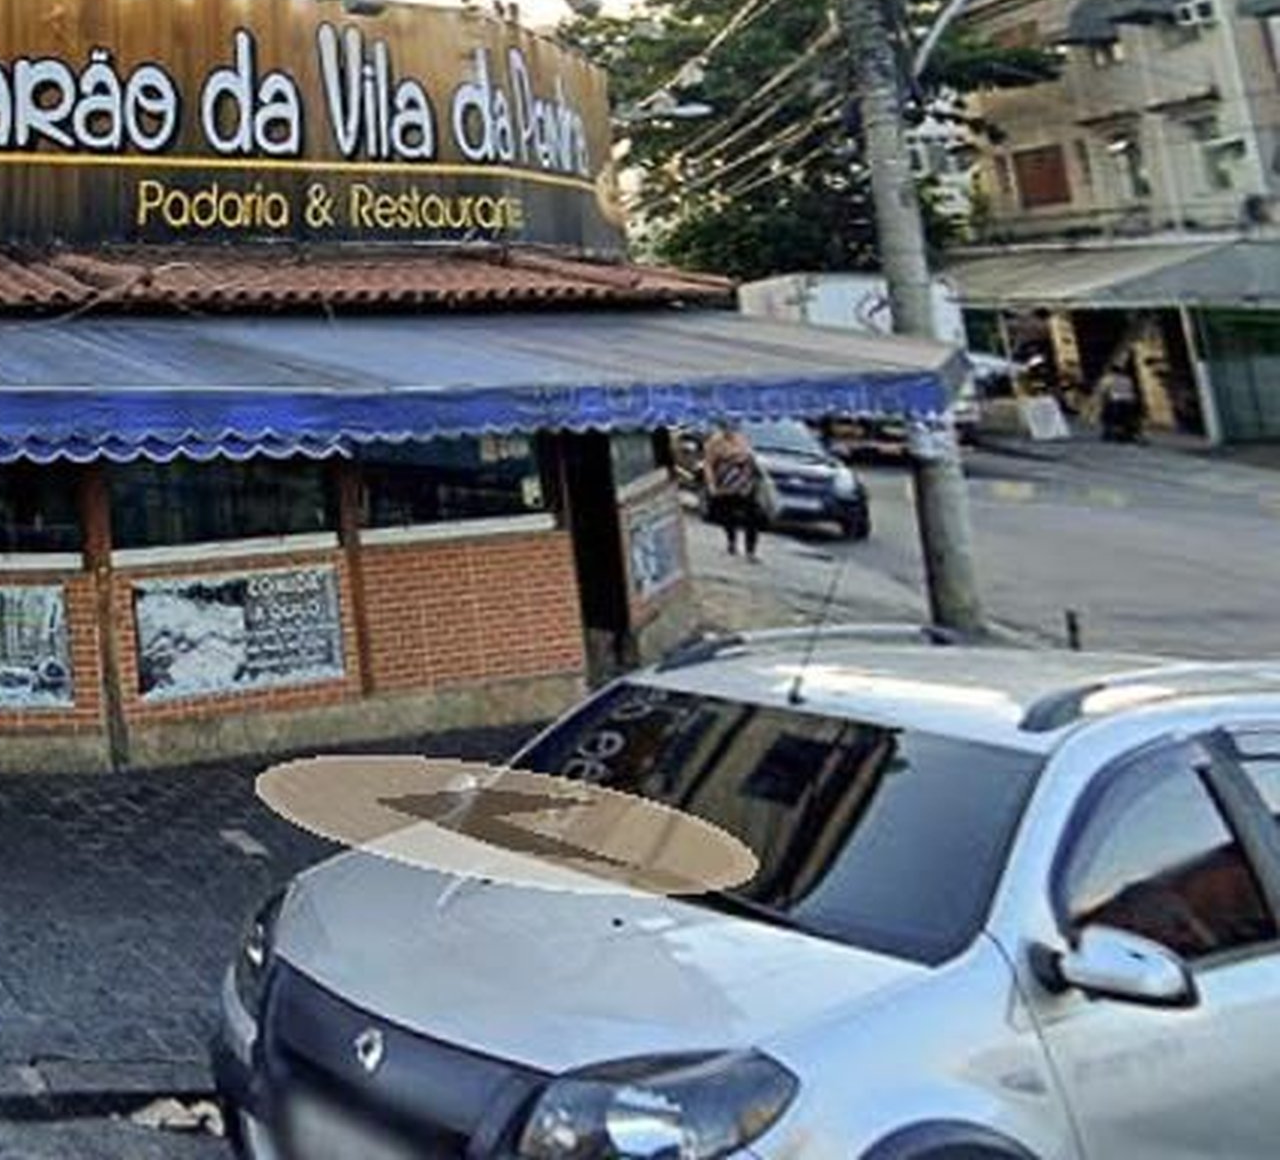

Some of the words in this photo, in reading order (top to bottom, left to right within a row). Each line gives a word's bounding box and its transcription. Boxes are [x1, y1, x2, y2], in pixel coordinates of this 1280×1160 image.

[201, 30, 299, 155] da
[319, 21, 432, 158] Vila
[453, 48, 514, 161] da
[137, 180, 289, 228] Padaria
[305, 183, 336, 228] &
